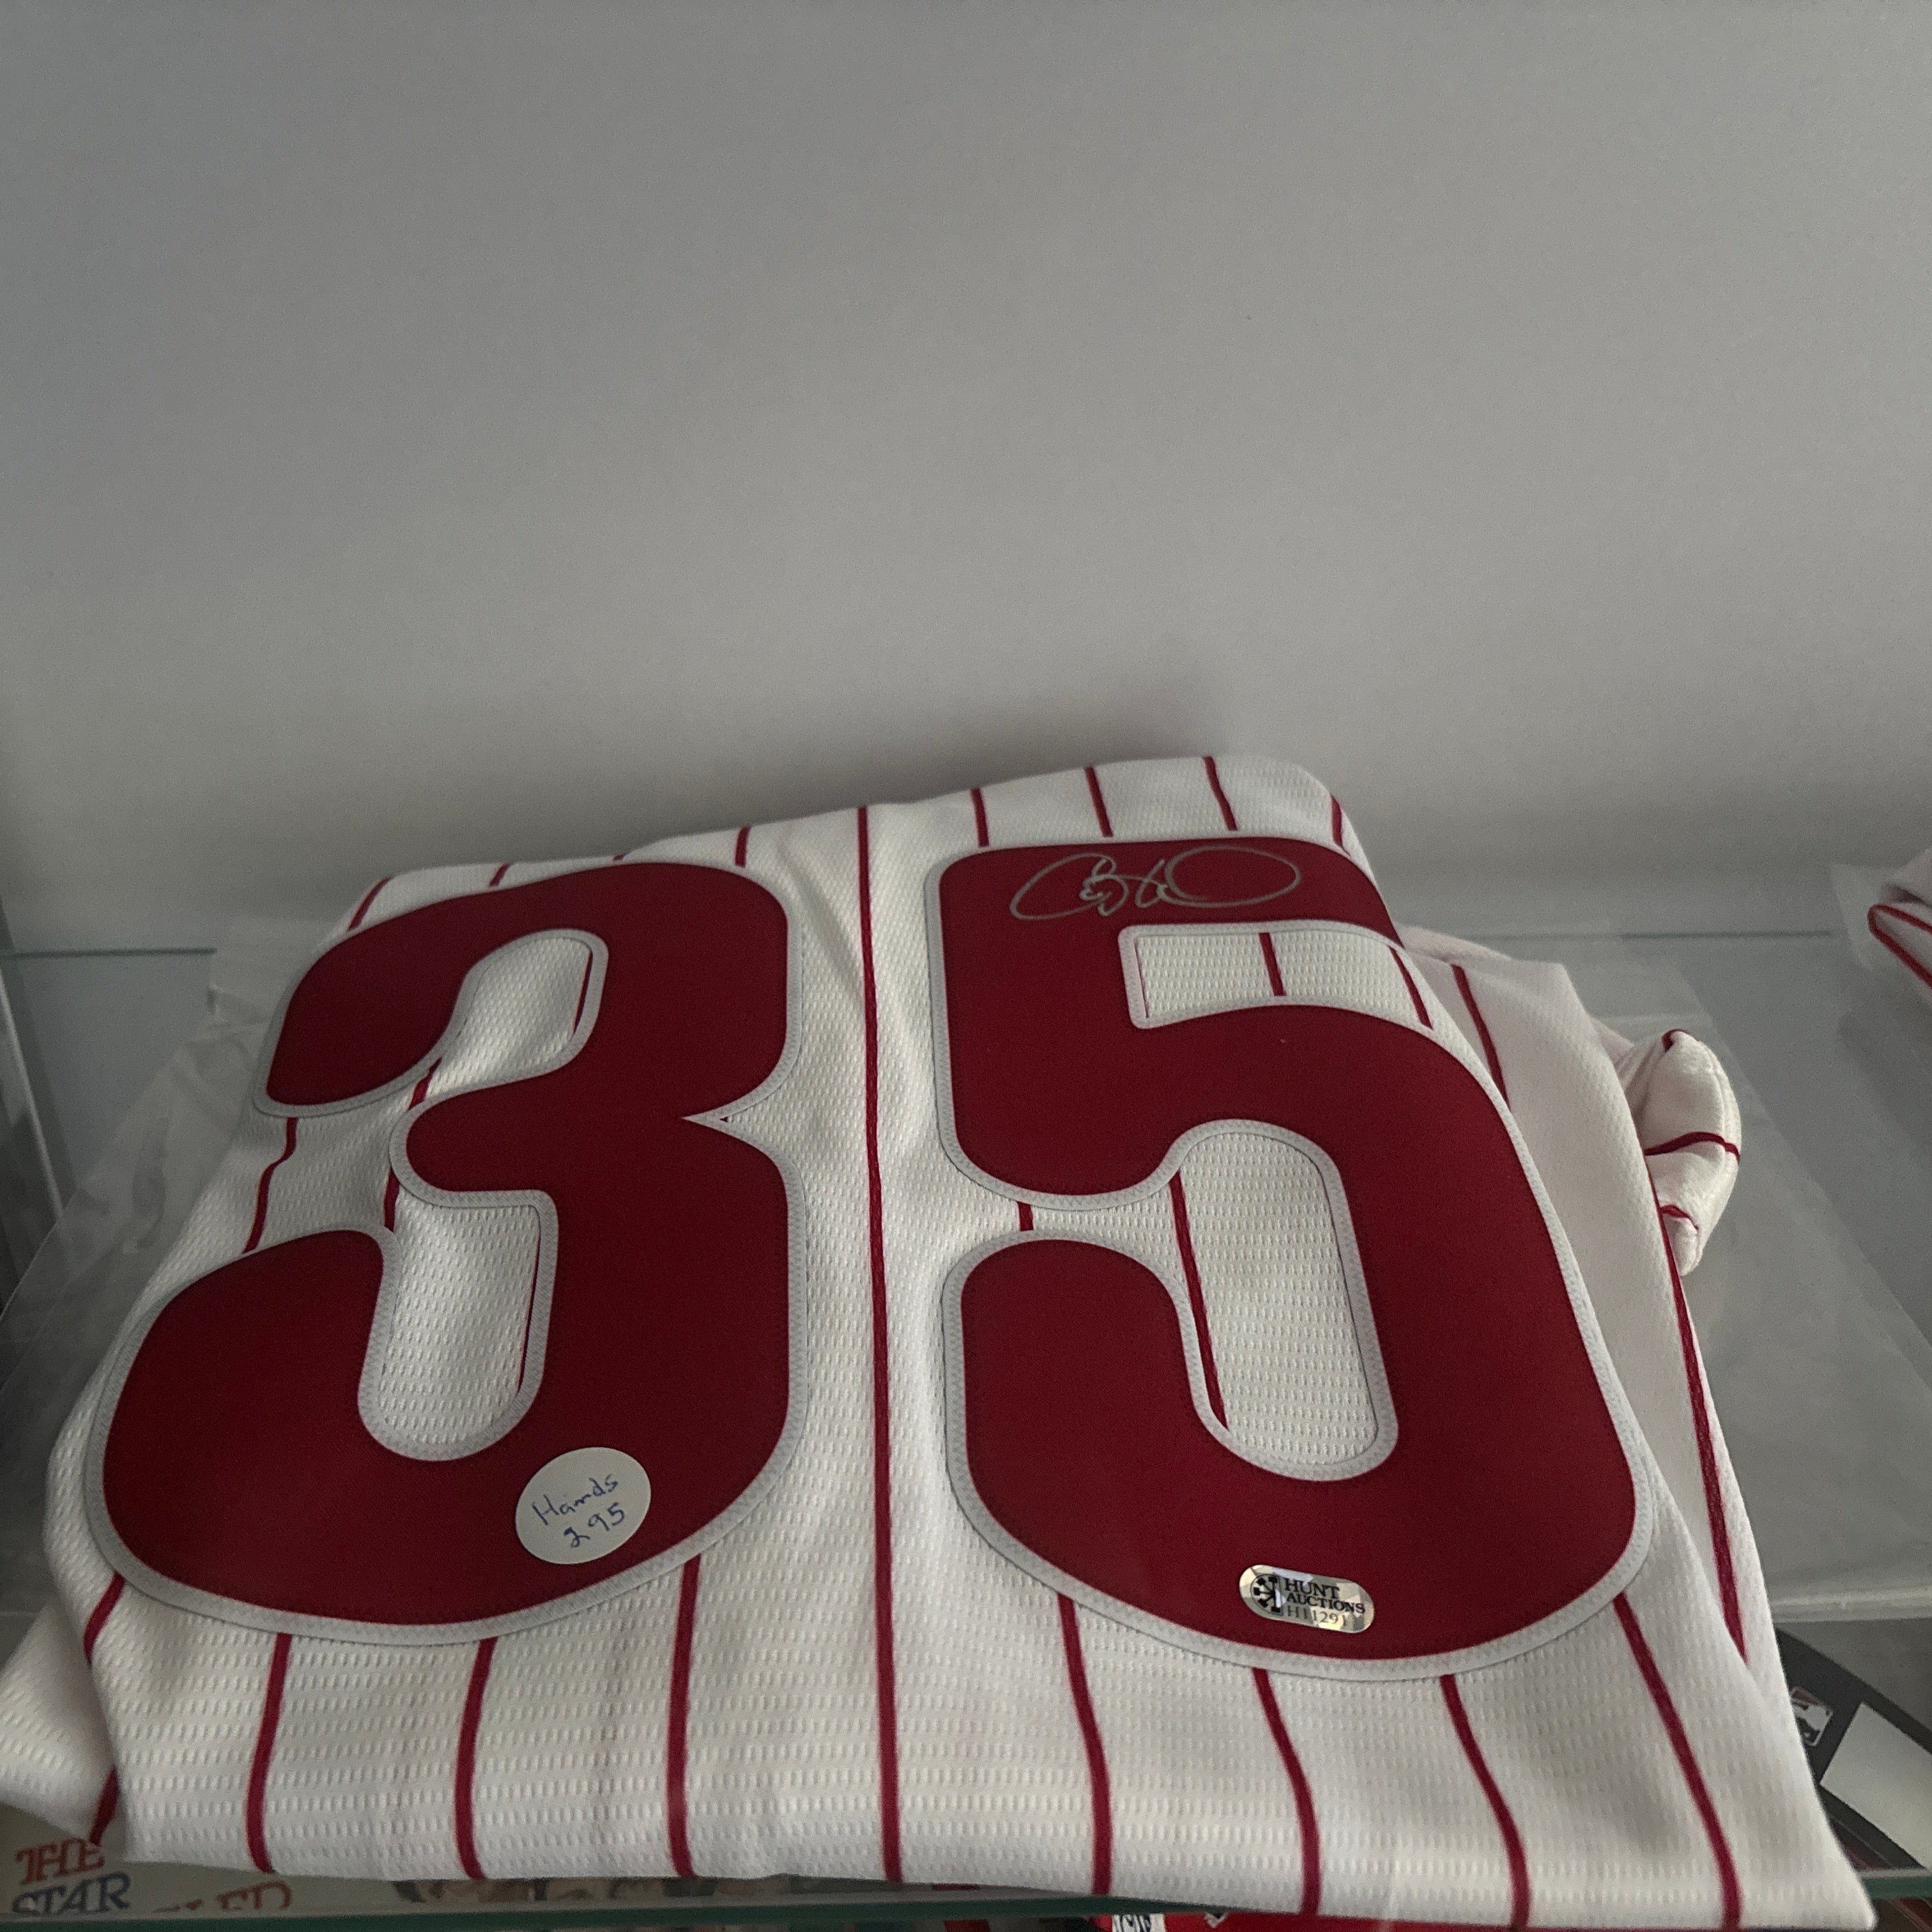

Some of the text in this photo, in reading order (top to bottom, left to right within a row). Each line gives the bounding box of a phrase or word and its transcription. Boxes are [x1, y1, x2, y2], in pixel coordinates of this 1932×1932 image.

[86, 837, 1652, 1683] 35
[563, 1501, 625, 1549] 295
[1284, 1577, 1340, 1600] HUNT
[1285, 1591, 1366, 1614] AUCTIONS
[15, 1837, 104, 1885] THE
[12, 1871, 132, 1917] STAR
